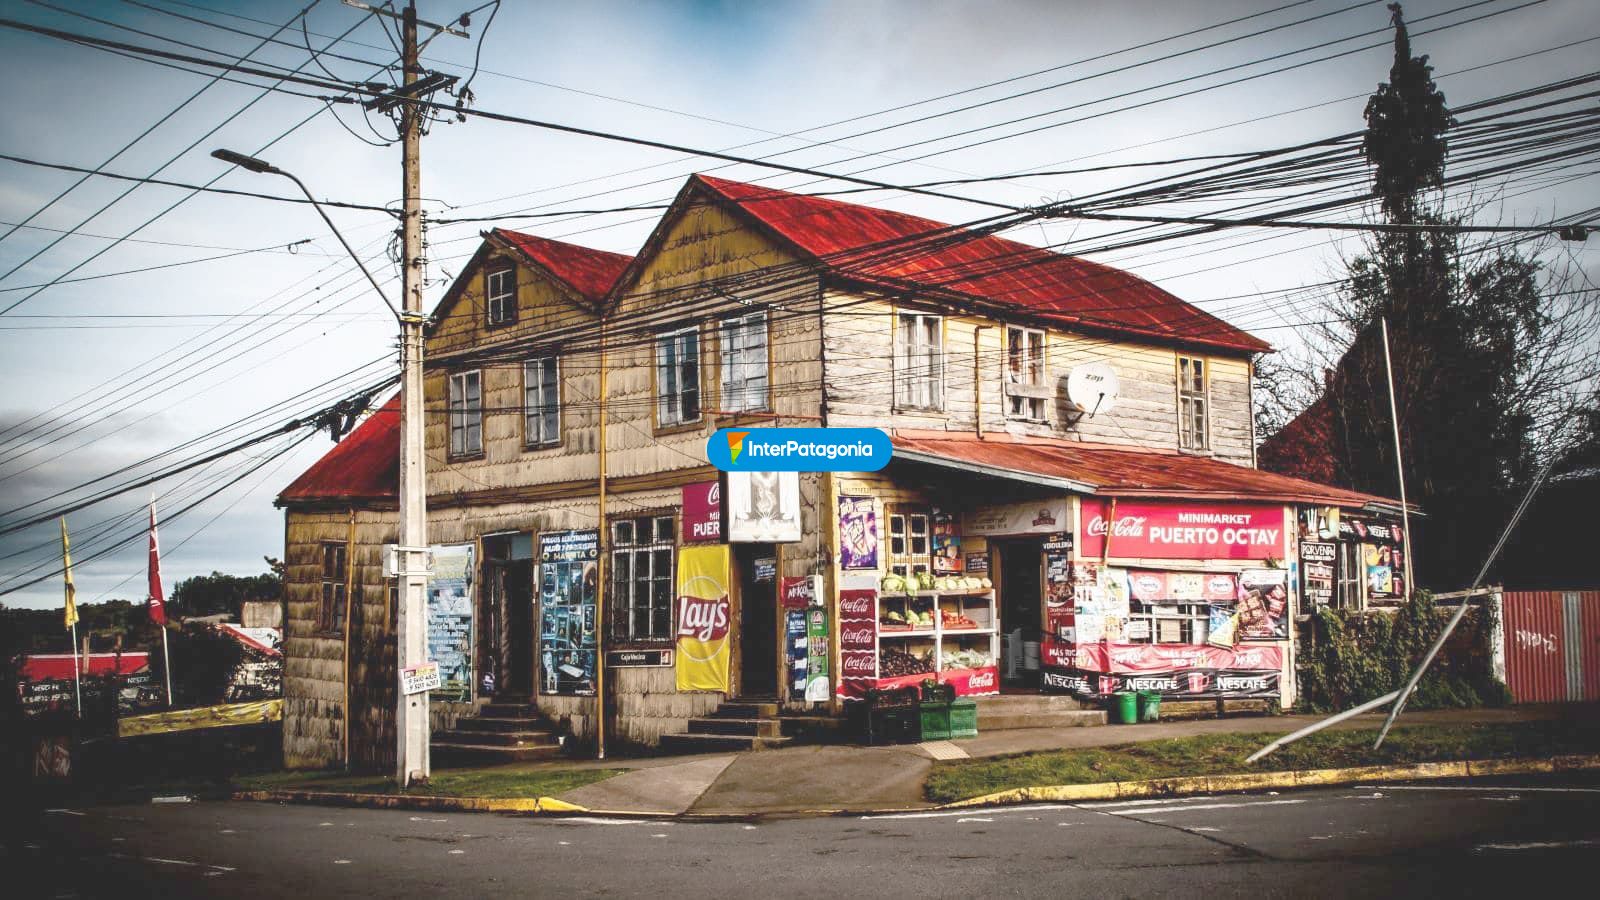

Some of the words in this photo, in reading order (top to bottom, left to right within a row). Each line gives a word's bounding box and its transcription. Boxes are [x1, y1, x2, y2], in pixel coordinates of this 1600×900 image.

[1087, 516, 1147, 537] Coca-Cola
[1178, 513, 1251, 525] MINIMARKET
[693, 521, 720, 537] PUER
[1150, 527, 1219, 544] PUERTO
[1222, 529, 1279, 546] OCTAY
[840, 598, 868, 613] Coca-Cola
[678, 597, 729, 642] Lay's
[842, 628, 873, 644] Coca-Cola
[845, 655, 876, 671] Coca-Cola
